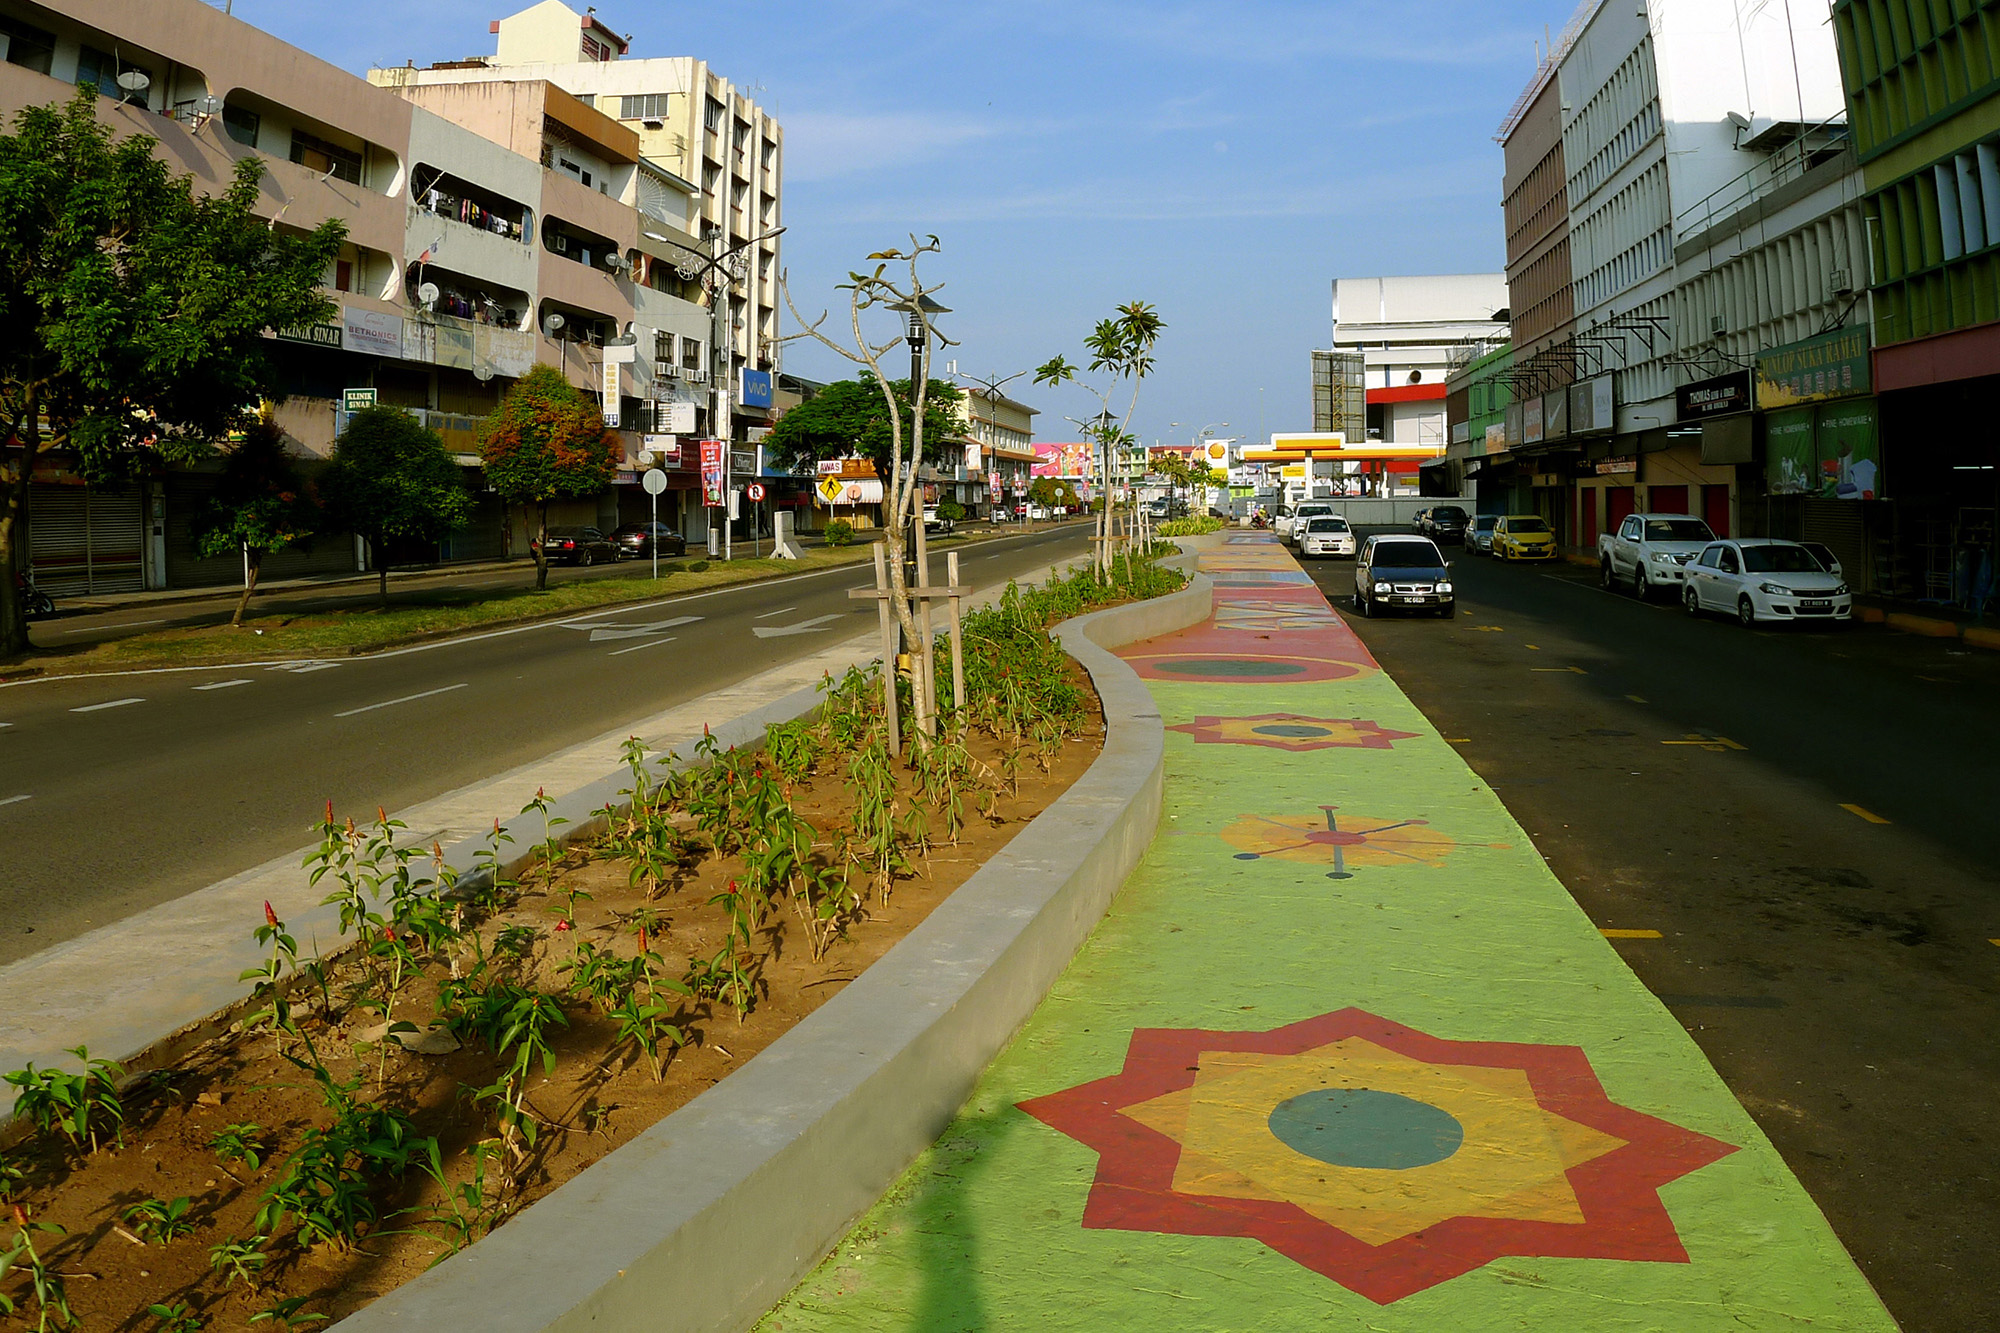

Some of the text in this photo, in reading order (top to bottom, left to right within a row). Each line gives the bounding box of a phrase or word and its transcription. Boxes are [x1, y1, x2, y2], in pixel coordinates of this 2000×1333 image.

[313, 326, 340, 345] SINAR
[348, 325, 397, 341] BETRONICS
[1797, 344, 1823, 370] SUKA
[1826, 333, 1862, 364] RAMAI
[347, 392, 373, 400] KLINIK
[1690, 388, 1710, 404] THOMAS
[819, 462, 840, 472] AWAS
